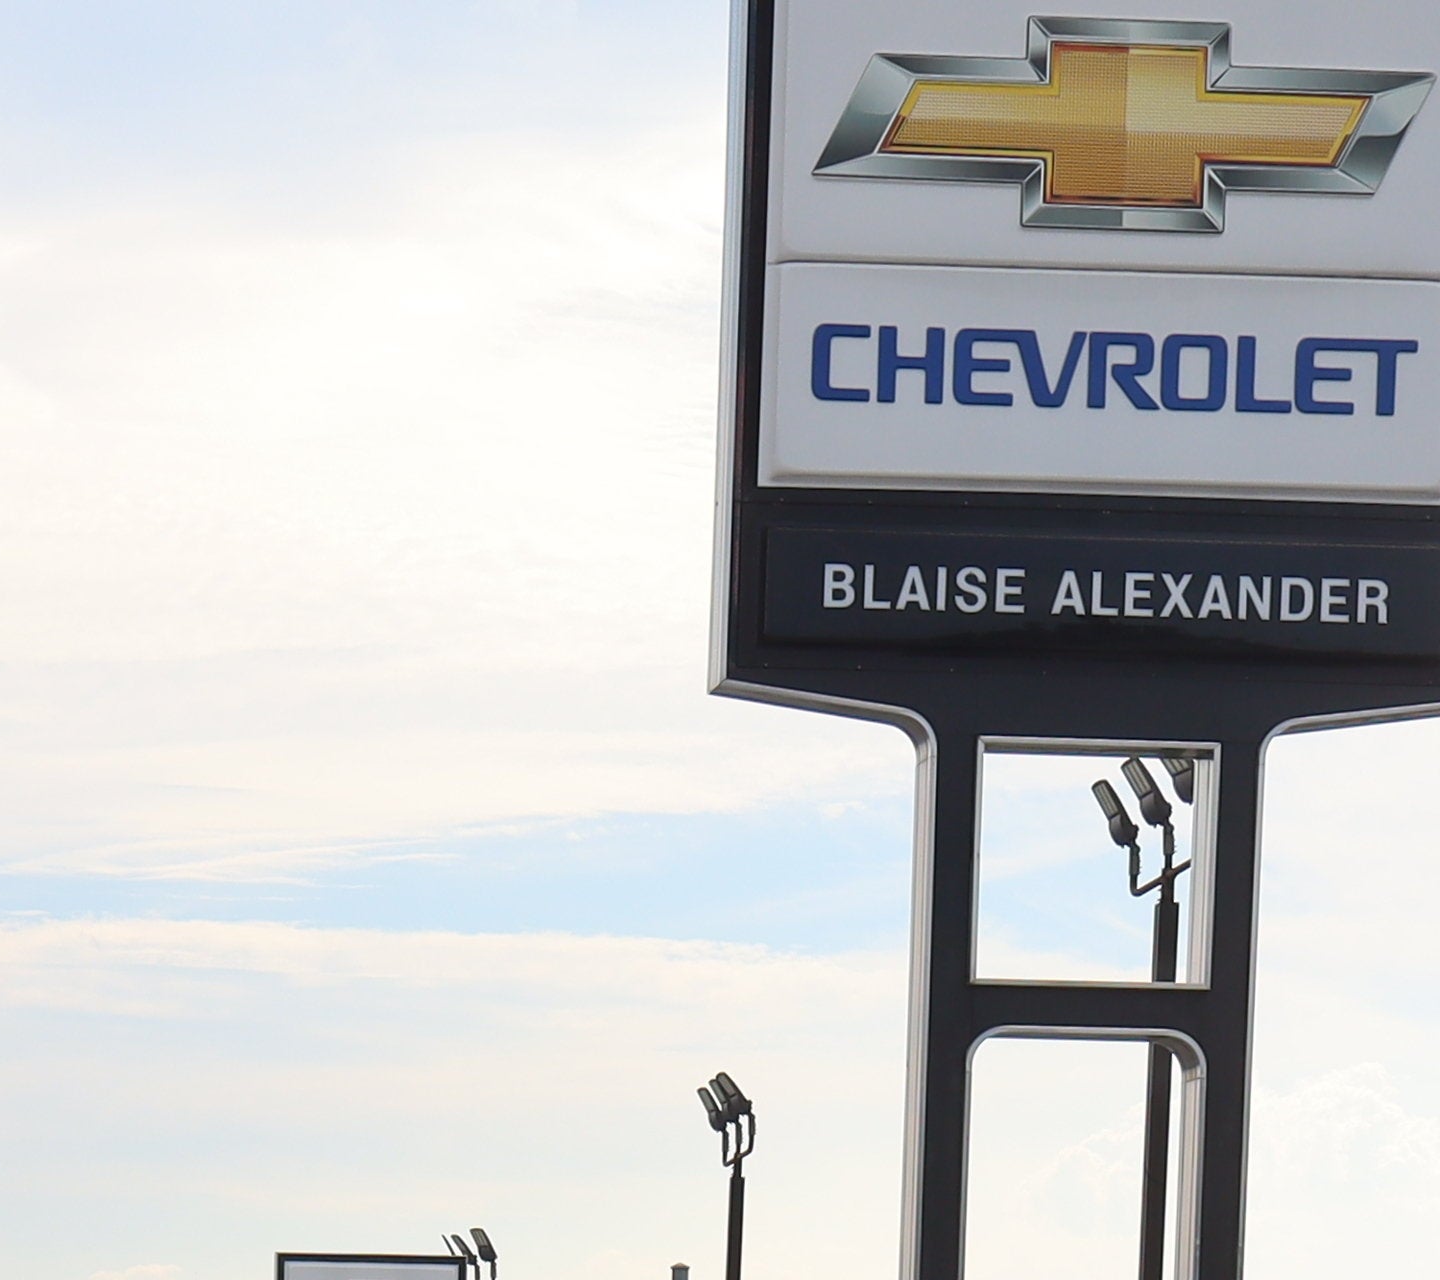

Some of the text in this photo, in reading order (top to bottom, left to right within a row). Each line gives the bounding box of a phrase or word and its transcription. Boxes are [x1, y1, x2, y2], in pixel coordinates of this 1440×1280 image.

[811, 322, 1419, 417] CHEVROLET
[822, 563, 1390, 624] BLAISE ALEXANDER
